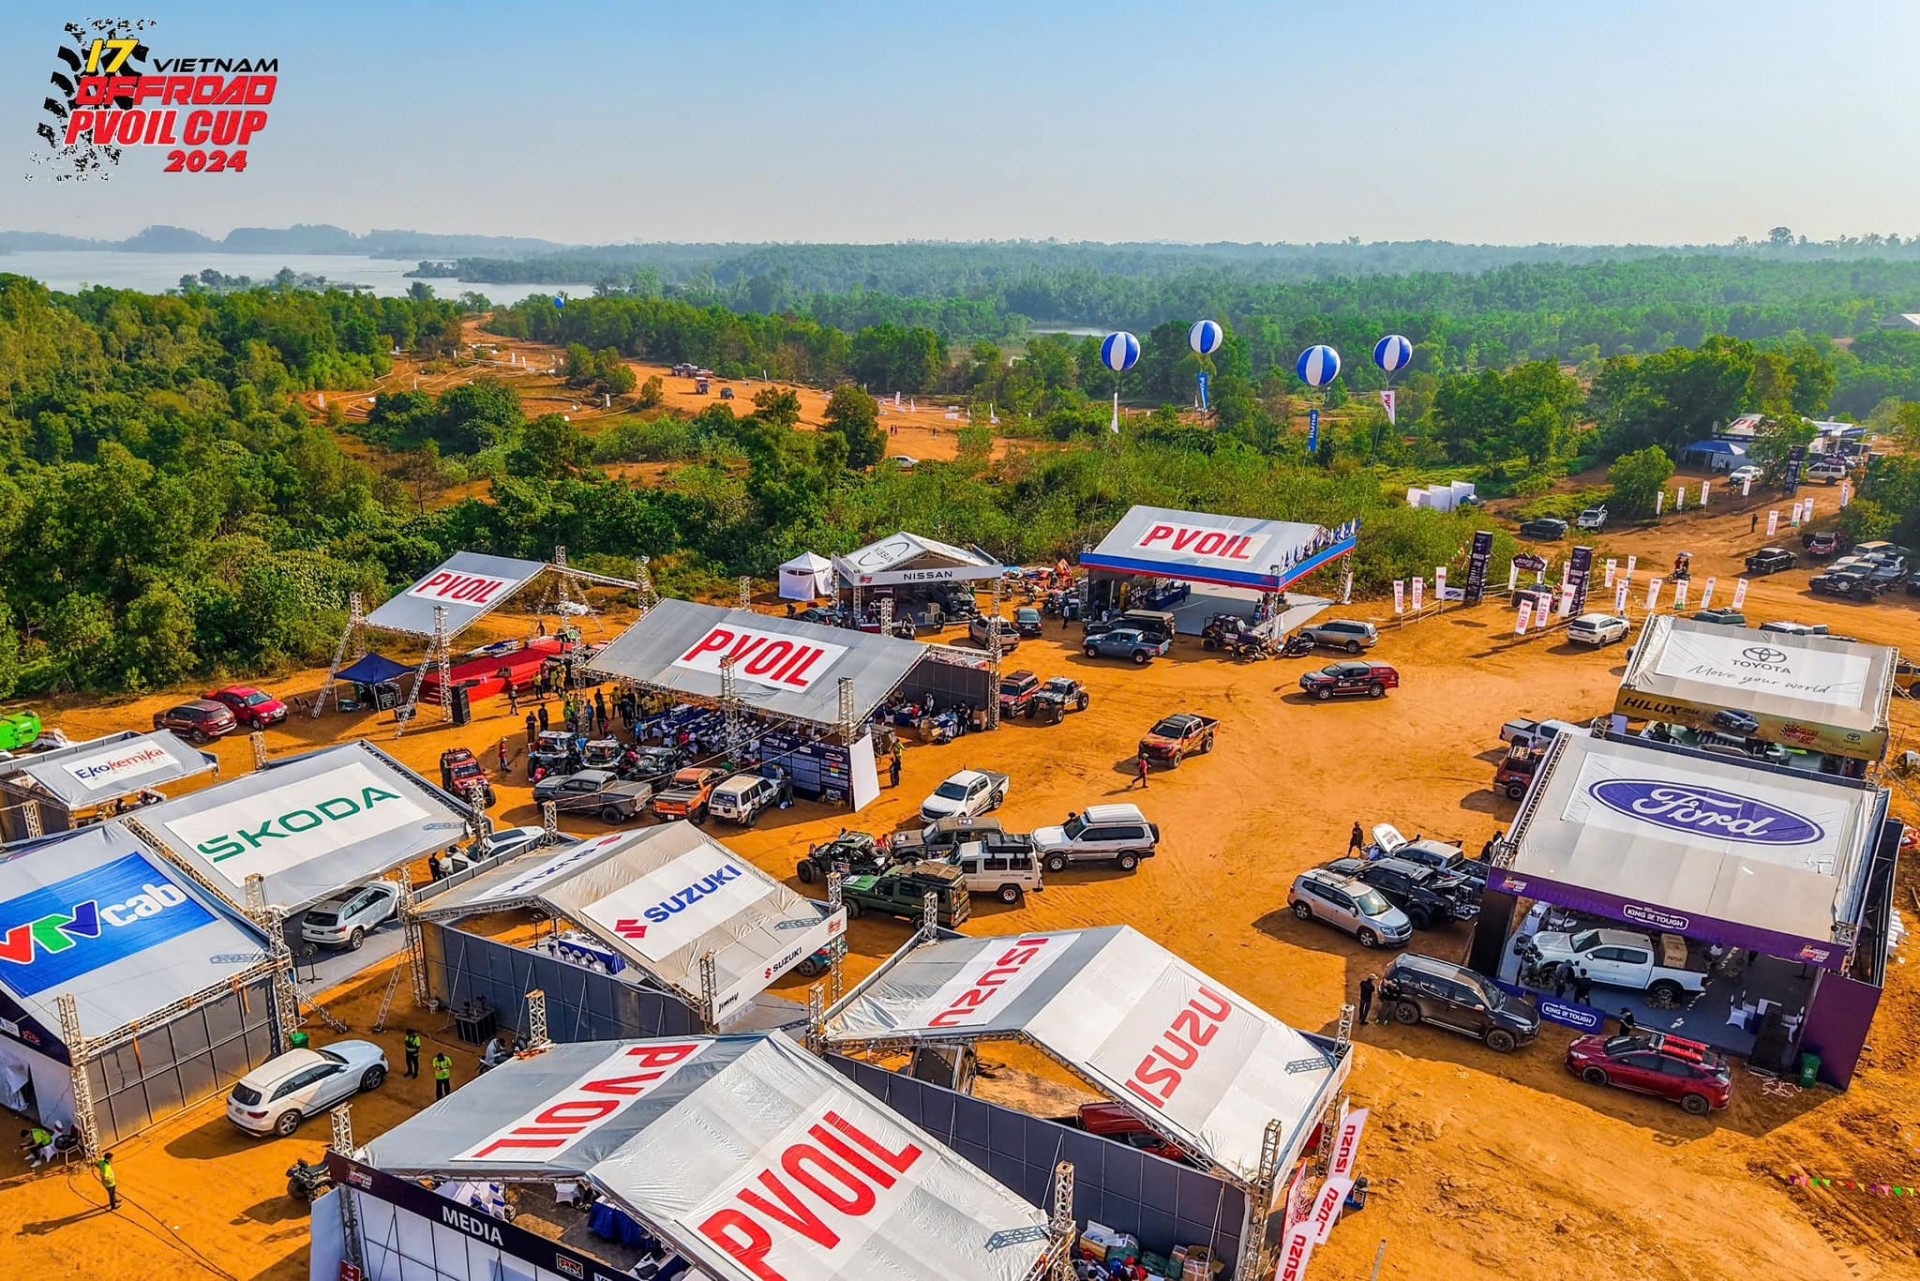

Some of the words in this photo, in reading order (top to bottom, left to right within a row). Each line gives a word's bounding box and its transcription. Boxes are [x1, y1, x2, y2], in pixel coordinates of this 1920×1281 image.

[1140, 525, 1251, 559] PVOIL
[416, 572, 504, 603] PVOIL
[903, 570, 953, 580] NISSAN
[682, 629, 825, 687] PVOIL
[1732, 660, 1791, 674] TOYOTA
[1687, 665, 1738, 679] Move
[1738, 676, 1780, 685] your
[1785, 682, 1830, 693] world
[1623, 697, 1681, 715] HILUX
[75, 748, 164, 779] Ekokemika
[1632, 789, 1776, 836] Ford
[643, 864, 742, 922] SUZUKI
[1627, 909, 1646, 918] KING
[1656, 916, 1683, 927] TOUGH
[773, 947, 802, 972] SUZUKI
[927, 938, 1049, 1026] ISUZU
[1125, 986, 1231, 1108] ISUZU
[472, 1044, 700, 1158] PVOIL
[1334, 1124, 1356, 1173] ISUZU
[697, 1110, 923, 1281] PVOIL
[442, 1205, 503, 1246] MEDIA
[1283, 1234, 1306, 1281] SUZU
